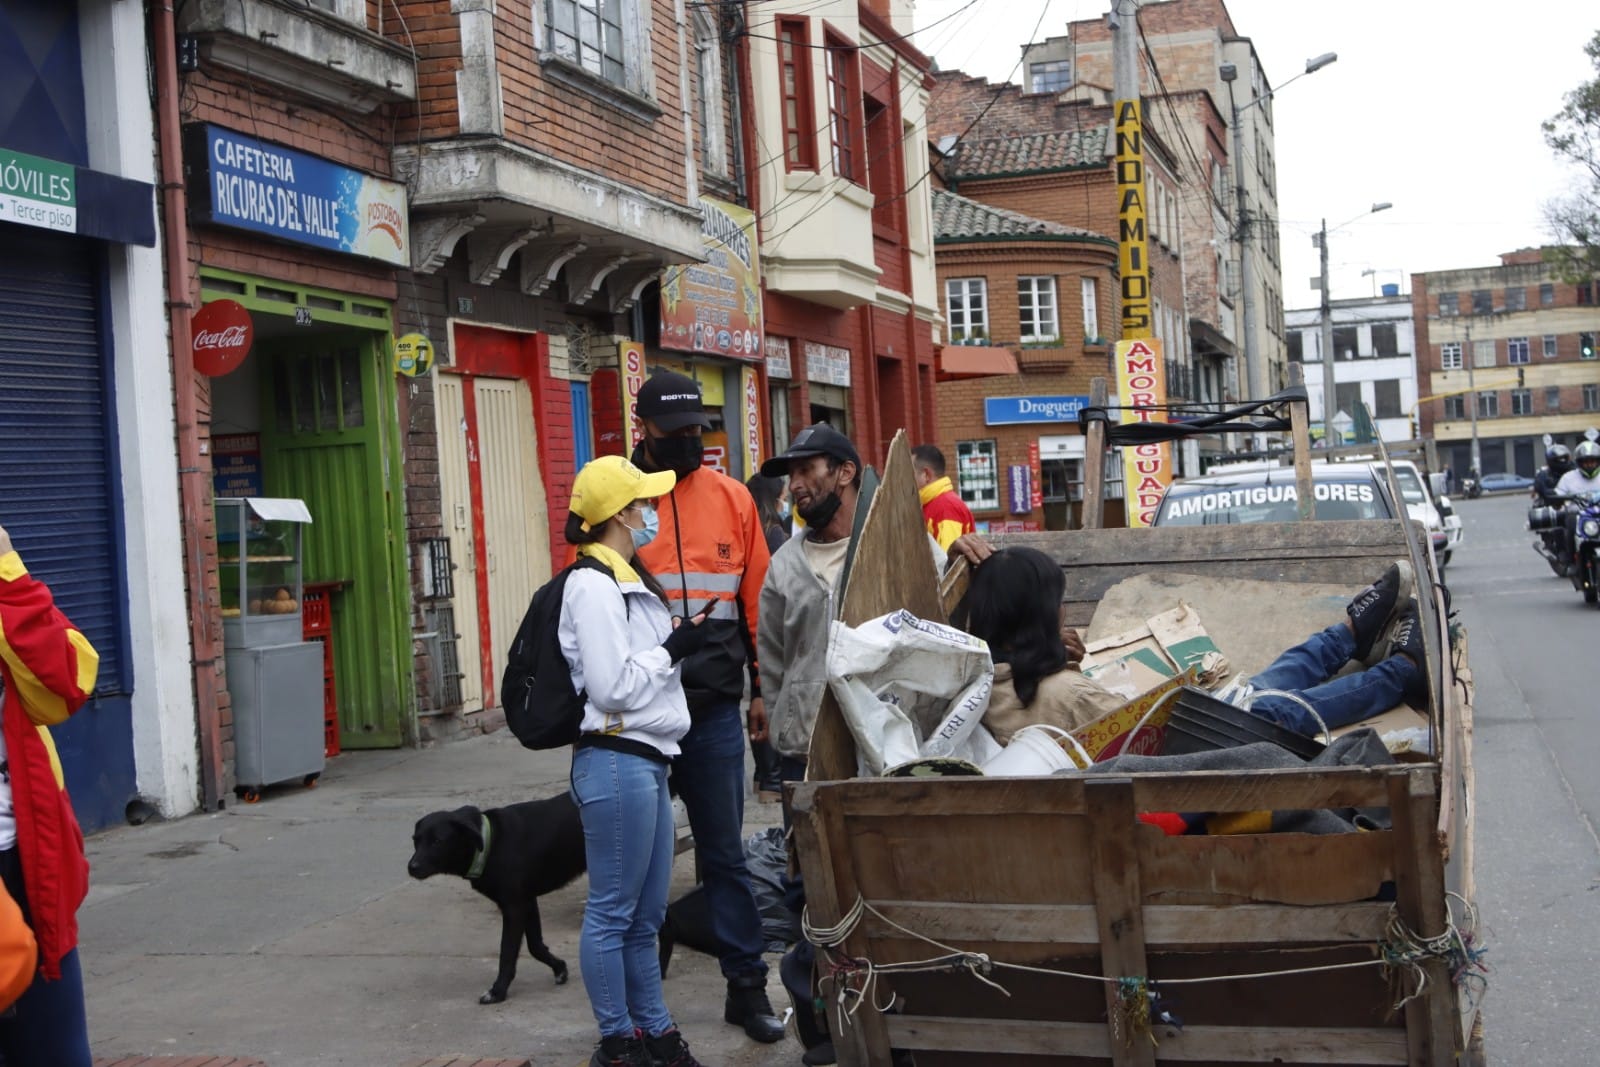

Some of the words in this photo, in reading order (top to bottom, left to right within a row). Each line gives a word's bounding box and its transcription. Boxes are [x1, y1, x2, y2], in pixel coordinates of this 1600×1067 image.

[214, 138, 295, 184] CAFETERIA
[10, 199, 46, 222] Tercer
[49, 208, 72, 229] piso
[216, 171, 276, 226] RICURAS
[276, 187, 302, 231] DEL
[301, 193, 340, 240] VALLE
[701, 202, 752, 270] UADORES
[1116, 101, 1149, 329] ANDAMIOS
[1127, 342, 1163, 525] AMORTGUAD
[1167, 483, 1374, 520] AMORTIGUAORES
